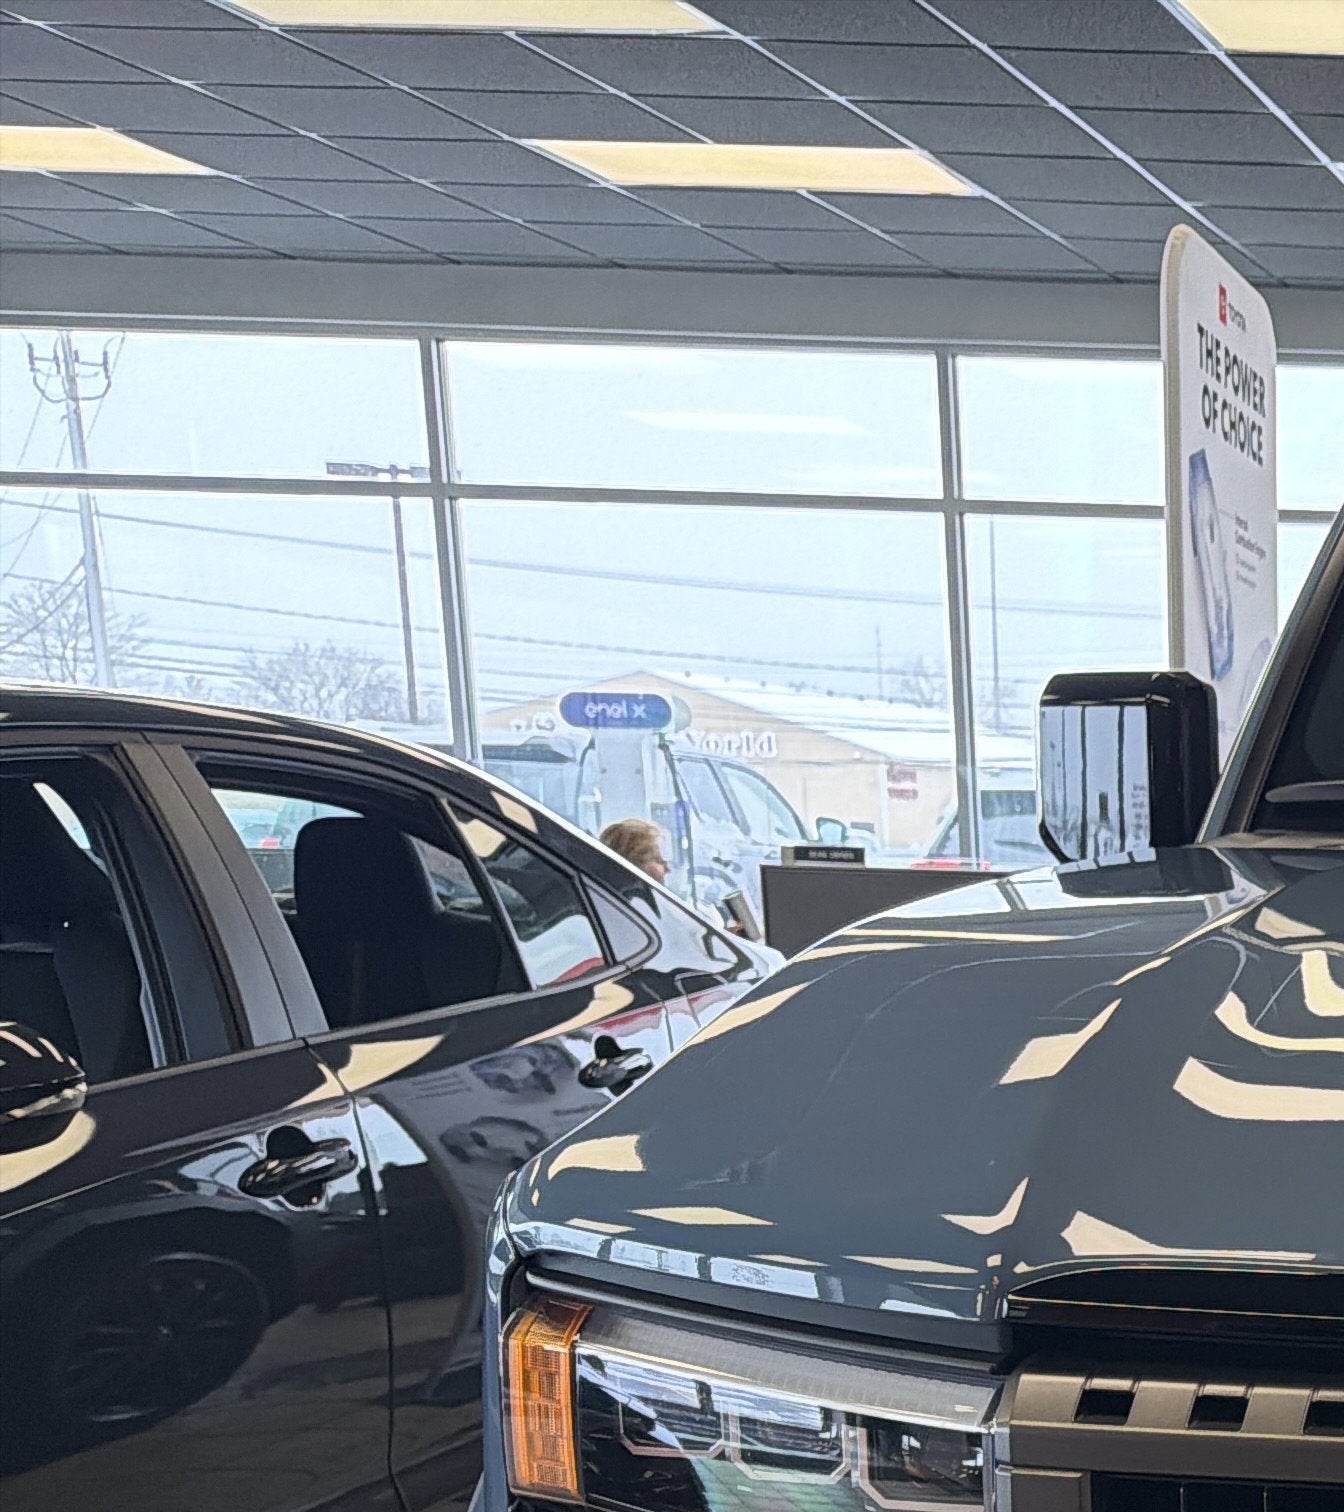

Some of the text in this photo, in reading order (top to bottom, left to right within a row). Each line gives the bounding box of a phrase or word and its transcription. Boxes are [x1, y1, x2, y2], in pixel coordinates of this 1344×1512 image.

[1196, 321, 1267, 418] THE POWER
[1201, 383, 1264, 468] OF CHOICE
[584, 699, 628, 719] enel
